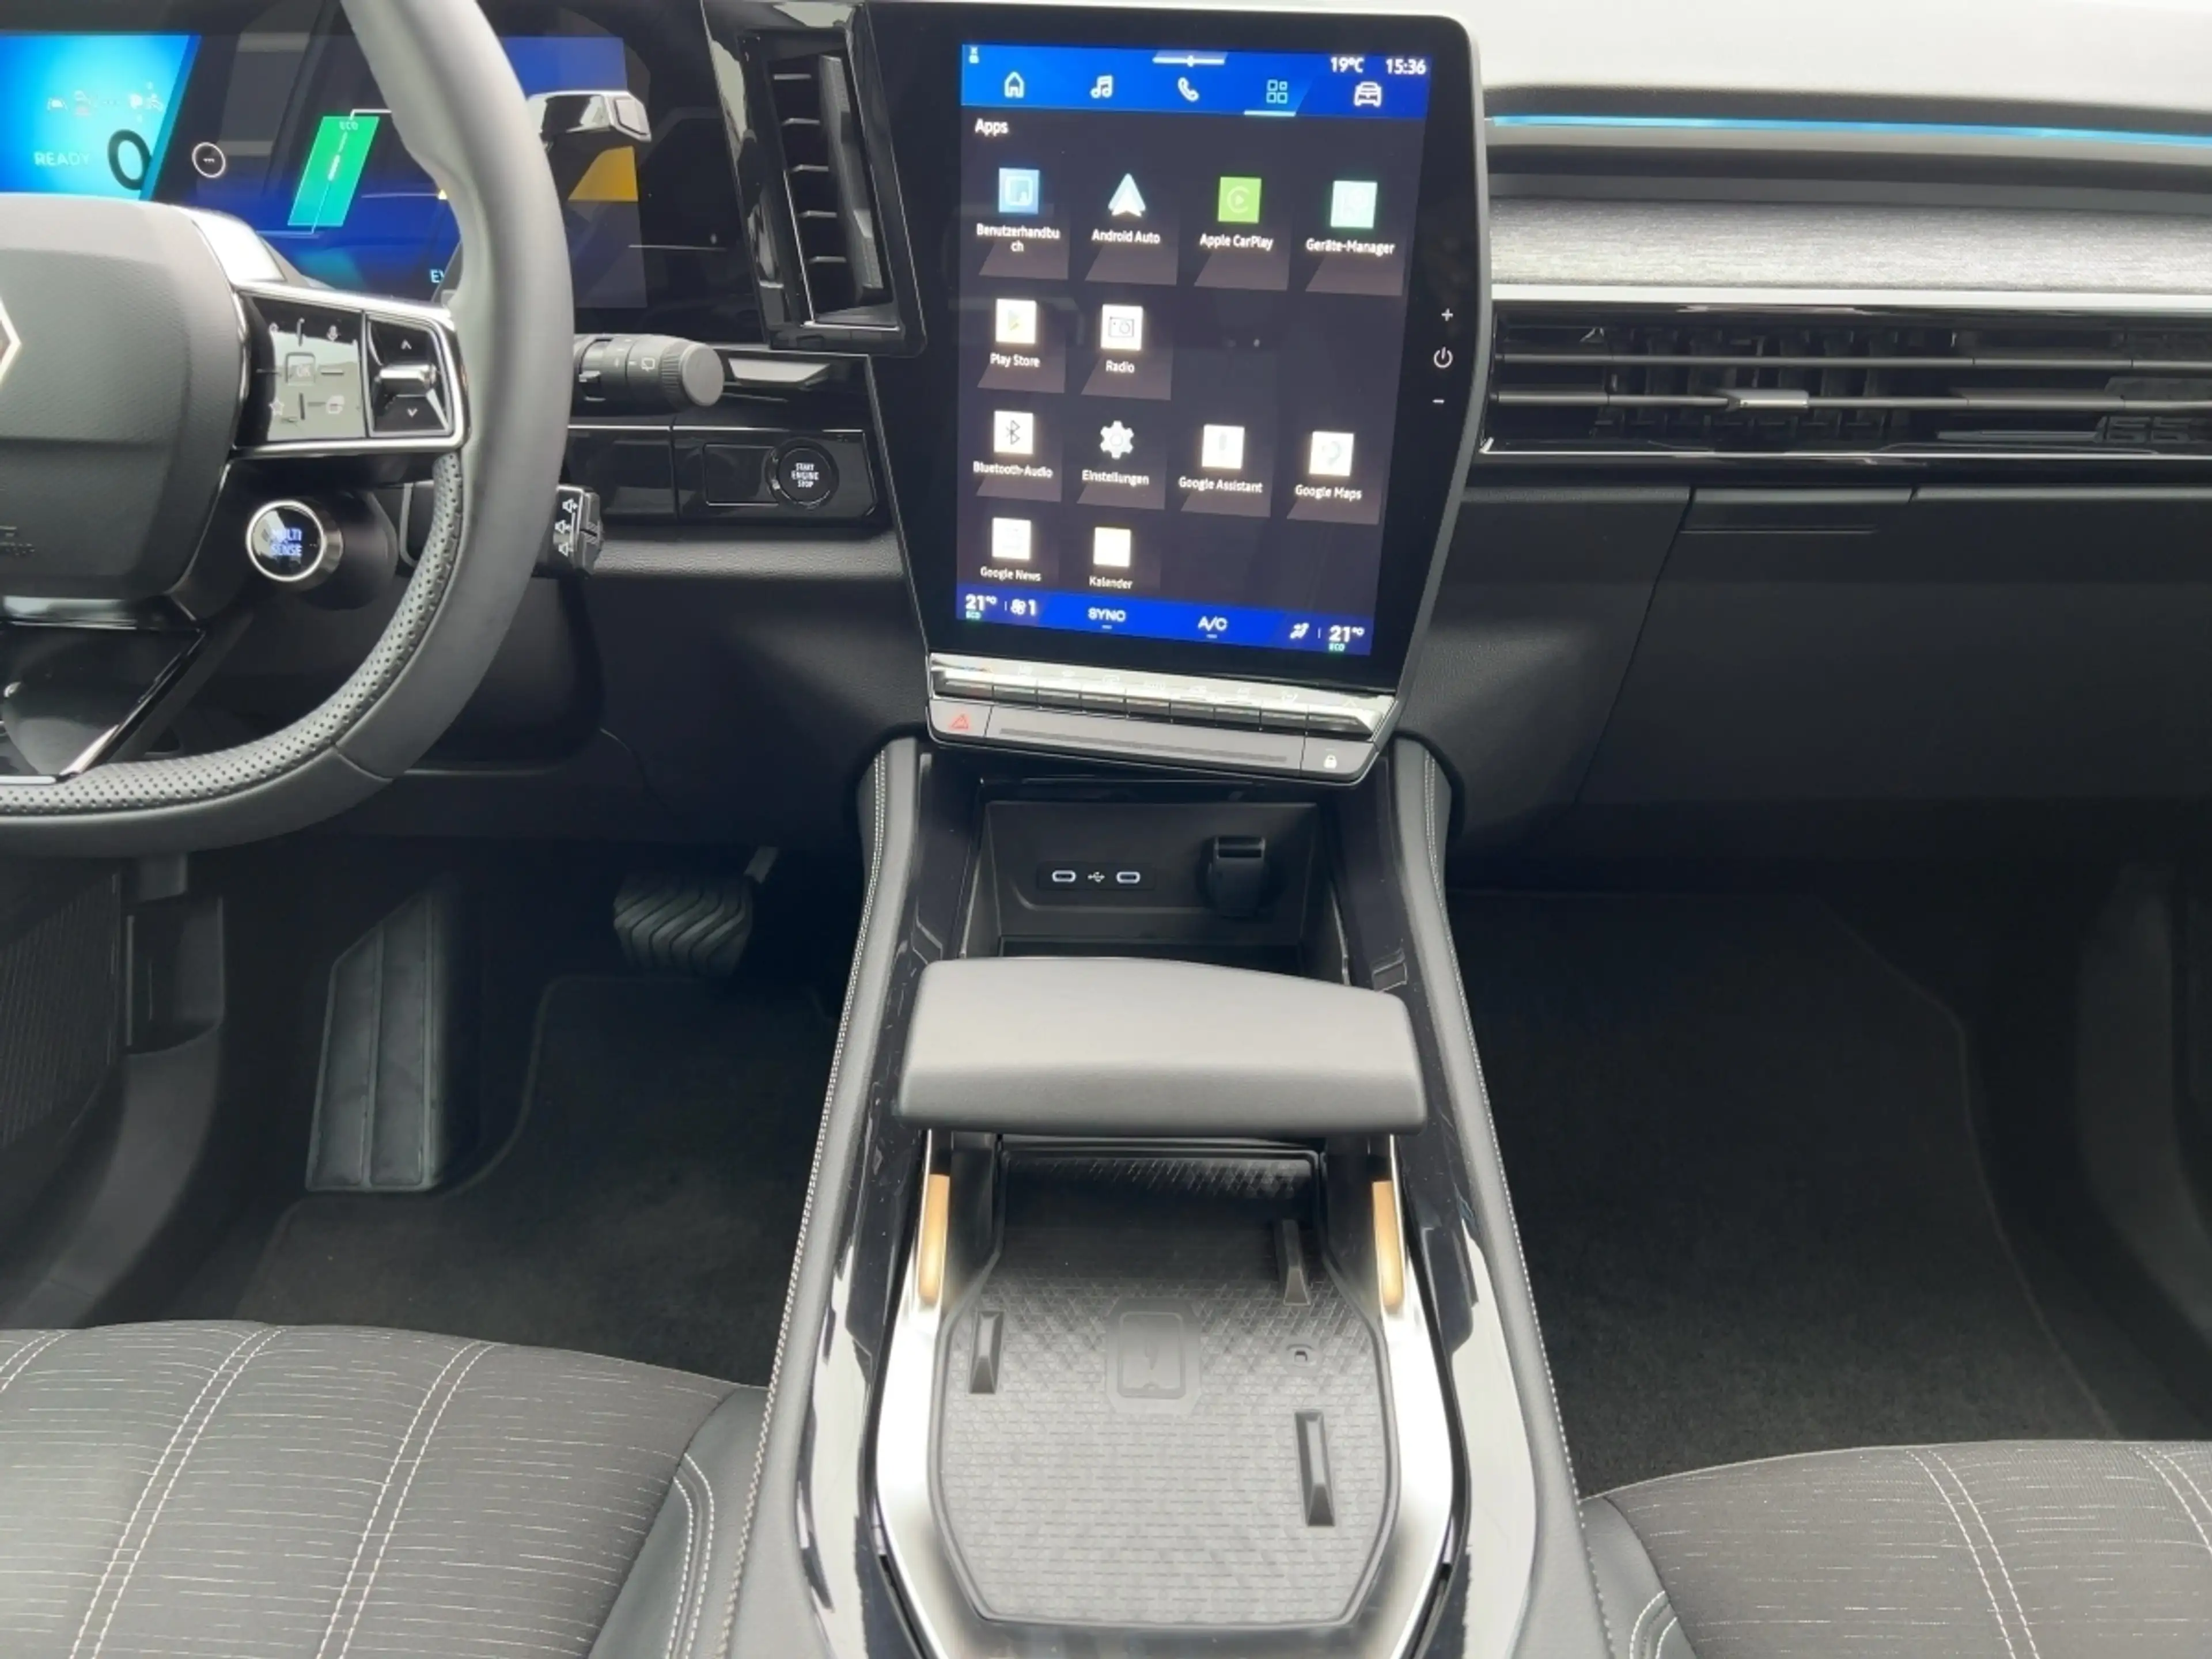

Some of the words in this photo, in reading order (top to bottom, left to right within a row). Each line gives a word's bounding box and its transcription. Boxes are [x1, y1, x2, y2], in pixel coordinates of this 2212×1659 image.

[1385, 58, 1426, 75] 15:36
[975, 118, 1009, 137] Apps
[33, 152, 90, 166] READY
[108, 128, 151, 191] 0
[976, 223, 1061, 239] Benutzerhandbu
[1091, 228, 1133, 243] Android
[1134, 230, 1161, 244] Auto
[1010, 240, 1024, 252] ch
[1199, 232, 1232, 249] Apple
[1233, 233, 1275, 252] CarPlay
[1305, 237, 1396, 257] Geräte-Manager
[990, 351, 1011, 368] Play
[1013, 354, 1040, 368] Store
[1105, 359, 1135, 374] Radio
[796, 462, 815, 471] START
[973, 460, 1054, 479] Bluetooth-Audio
[791, 470, 819, 480] ENGINE
[1082, 469, 1149, 487] Einstellungen
[797, 479, 813, 488] STOP
[1178, 475, 1215, 492] Google
[1216, 478, 1263, 494] Assistant
[1294, 483, 1332, 501] Google
[1334, 486, 1362, 503] Maps
[270, 544, 302, 556] SENSE
[980, 566, 1013, 582] Google
[1015, 569, 1041, 582] News
[1089, 575, 1133, 589] Kalender
[965, 611, 982, 620] ECO
[1027, 599, 1036, 616] 1
[1088, 607, 1126, 623] SYNC
[1198, 615, 1228, 631] A/C
[1328, 643, 1345, 652] ECO
